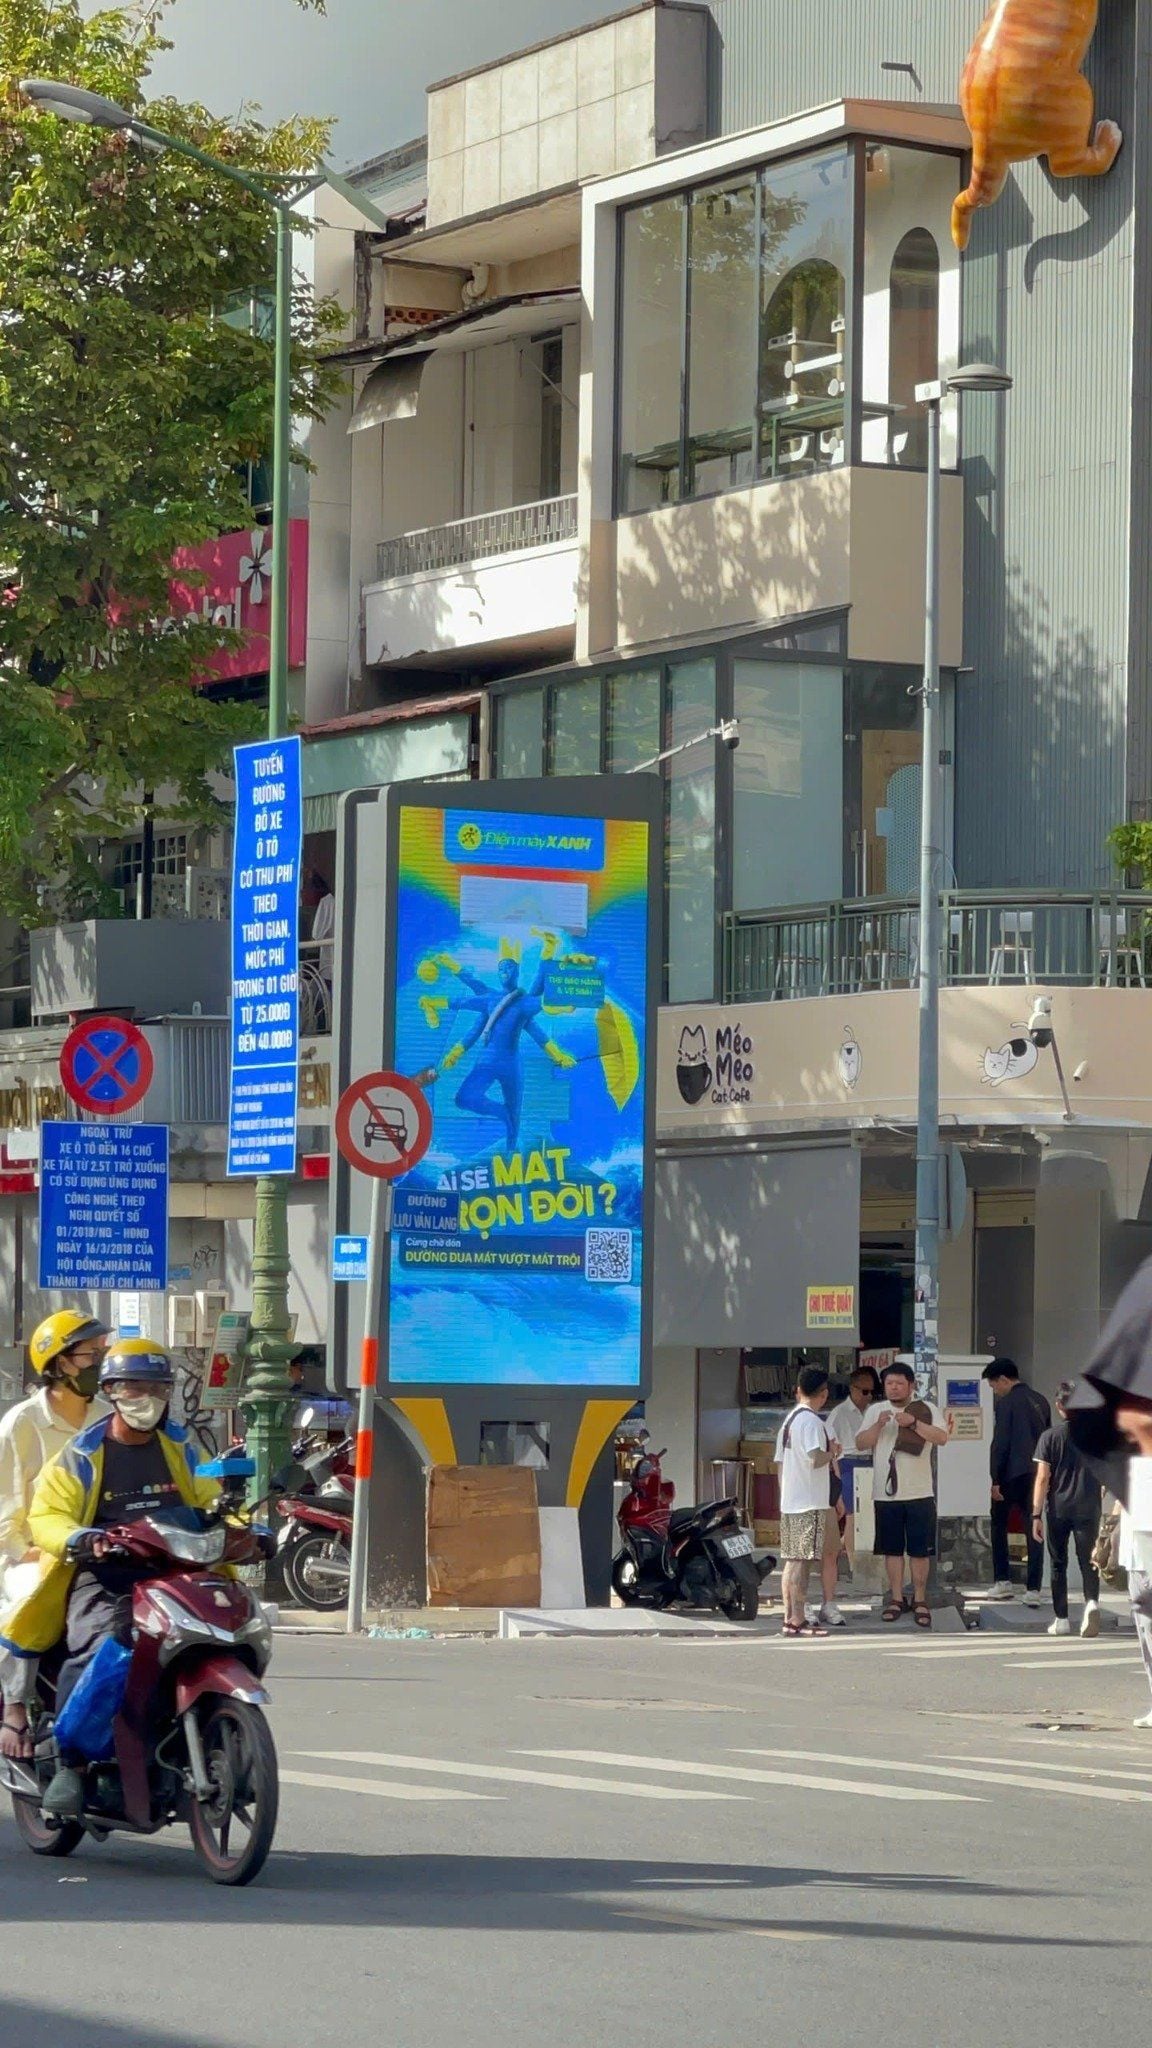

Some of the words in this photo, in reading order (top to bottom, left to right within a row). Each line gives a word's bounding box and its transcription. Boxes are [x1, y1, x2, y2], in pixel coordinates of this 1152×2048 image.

[253, 749, 284, 778] TUYẾN
[253, 780, 285, 806] ĐƯỜNG
[255, 807, 268, 832] ĐỖ
[270, 810, 283, 830] XE
[256, 838, 264, 859] Ô
[266, 835, 278, 858] TÔ
[546, 835, 592, 850] XANH
[240, 864, 253, 889] CÓ
[255, 866, 274, 887] THU
[276, 857, 294, 884] PHÍ
[253, 892, 278, 914] THEO
[242, 918, 264, 943] THỜI
[245, 945, 267, 970] MỨC
[269, 941, 285, 967] PHÍ
[232, 977, 264, 998] TRONG
[267, 975, 277, 994] 01
[280, 968, 298, 993] GIỜ
[240, 1001, 253, 1025] TỪ
[238, 1027, 256, 1052] ĐẾN
[715, 1022, 752, 1056] Méo
[715, 1052, 753, 1087] Meo
[711, 1088, 728, 1103] Cat
[80, 1126, 109, 1140] NGOẠI
[114, 1125, 133, 1139] TRỪ
[60, 1142, 72, 1154] XE
[74, 1140, 81, 1154] Ô
[84, 1141, 96, 1155] TÔ
[98, 1140, 117, 1156] ĐẾN
[121, 1145, 130, 1156] 16
[133, 1142, 155, 1157] CHỖ
[43, 1159, 56, 1170] XE
[59, 1157, 73, 1171] TẢI
[76, 1158, 89, 1171] TỪ
[90, 1161, 111, 1172] 2.5T
[114, 1158, 132, 1172] TRỞ
[134, 1158, 166, 1174] XUỐNG
[49, 1172, 62, 1186] CÓ
[64, 1172, 78, 1187] SỬ
[80, 1176, 107, 1190] DỤNG
[108, 1175, 129, 1189] ỨNG
[131, 1178, 157, 1191] DỤNG
[460, 1165, 490, 1191] SẼ
[64, 1191, 91, 1205] CÔNG
[93, 1192, 118, 1208] NGHỆ
[121, 1194, 146, 1207] THEO
[407, 1194, 447, 1208] ĐƯỜNG
[69, 1209, 92, 1224] NGHỊ
[94, 1207, 125, 1222] QUYẾT
[126, 1208, 142, 1223] SỐ
[393, 1213, 412, 1228] LƯU
[413, 1211, 432, 1229] VĂN
[432, 1215, 457, 1230] LANG
[56, 1225, 112, 1238] 01/2018/NQ
[56, 1240, 82, 1254] NGÀY
[86, 1242, 132, 1255] 16/3/2018
[134, 1240, 154, 1256] CỦA
[405, 1237, 428, 1249] Cùng
[429, 1237, 444, 1248] chờ
[445, 1237, 462, 1248] đón
[57, 1257, 73, 1273] HỘI
[132, 1259, 152, 1272] DÂN
[405, 1249, 448, 1263] ĐƯỜNG
[449, 1251, 473, 1263] ĐUA
[474, 1250, 497, 1264] MÁT
[498, 1252, 530, 1267] VƯỢT
[46, 1273, 78, 1287] THÀNH
[80, 1272, 101, 1288] PHỐ
[102, 1274, 116, 1288] HỒ
[117, 1275, 135, 1288] CHÍ
[135, 1277, 160, 1289] MINH
